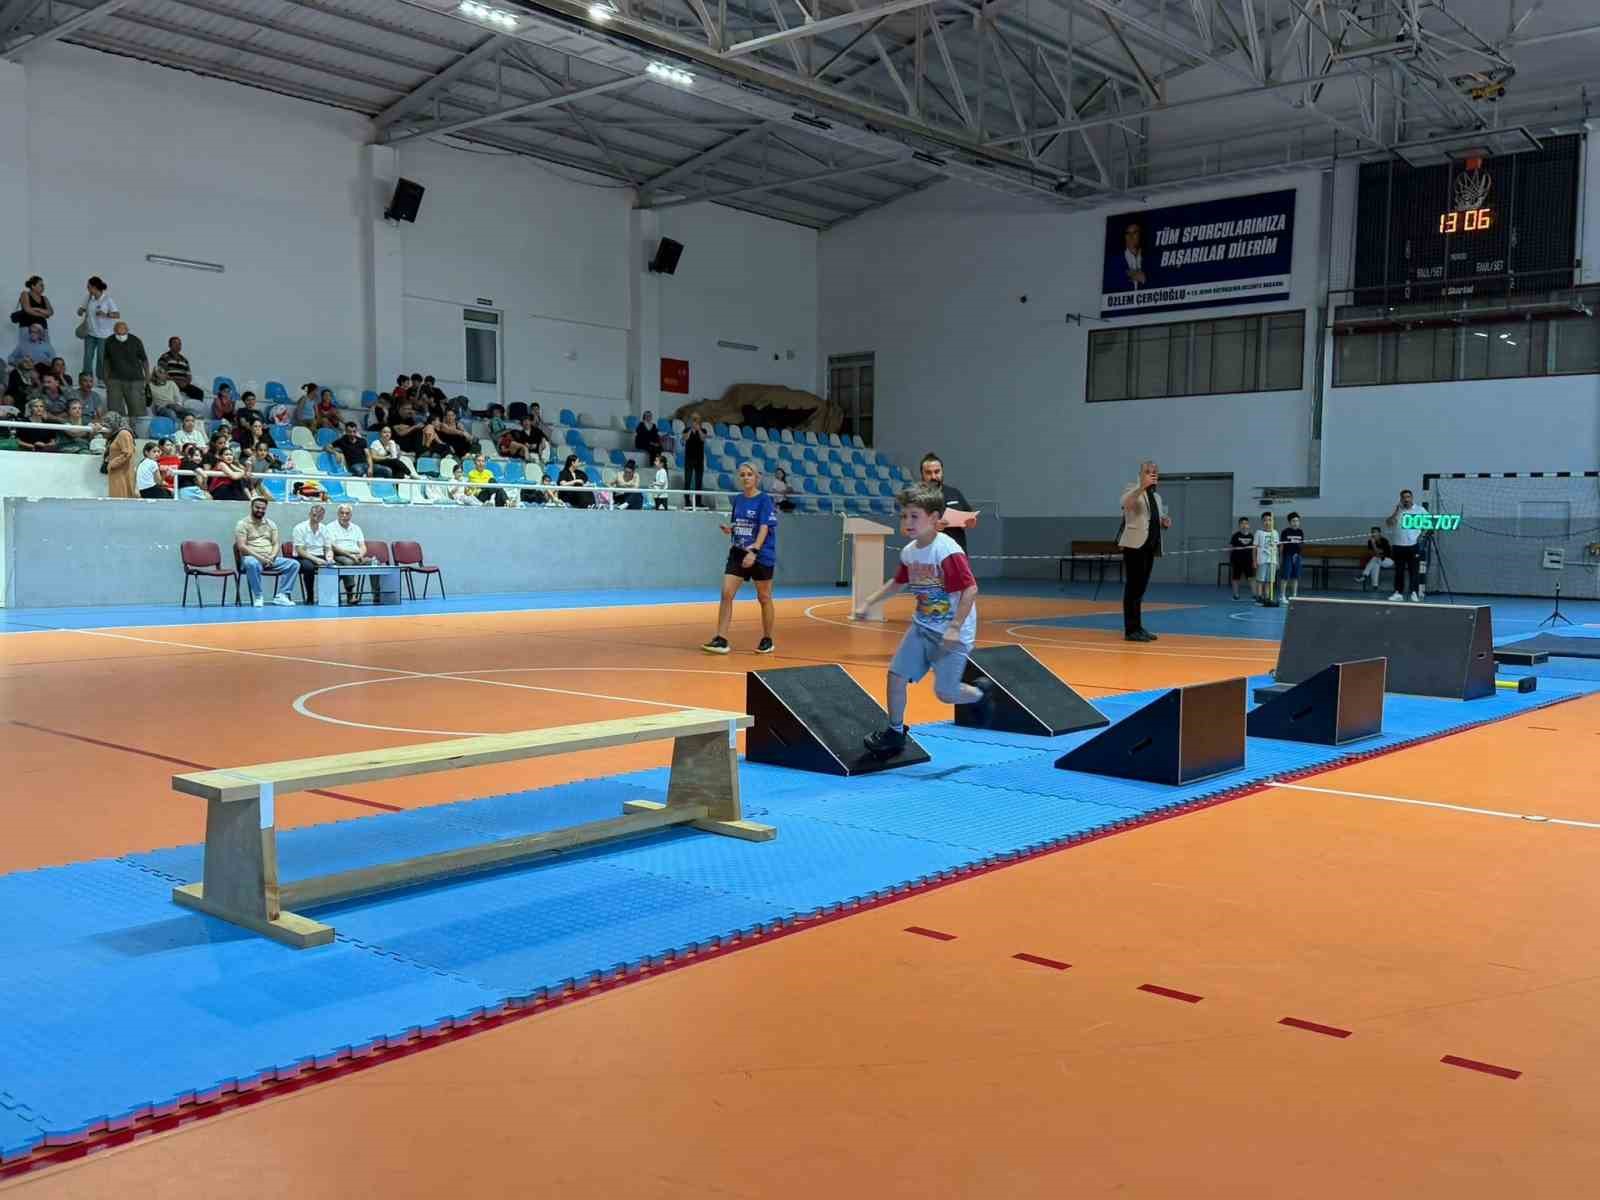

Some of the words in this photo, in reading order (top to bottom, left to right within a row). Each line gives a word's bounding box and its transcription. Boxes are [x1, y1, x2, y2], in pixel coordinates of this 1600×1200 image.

[1155, 227, 1181, 246] TÜM
[1182, 214, 1287, 242] SPORCULARIMIZA
[1439, 212, 1458, 233] 13
[1464, 208, 1491, 231] 06
[1160, 243, 1226, 268] BAŞARILAR
[1228, 236, 1279, 259] DİLERİM
